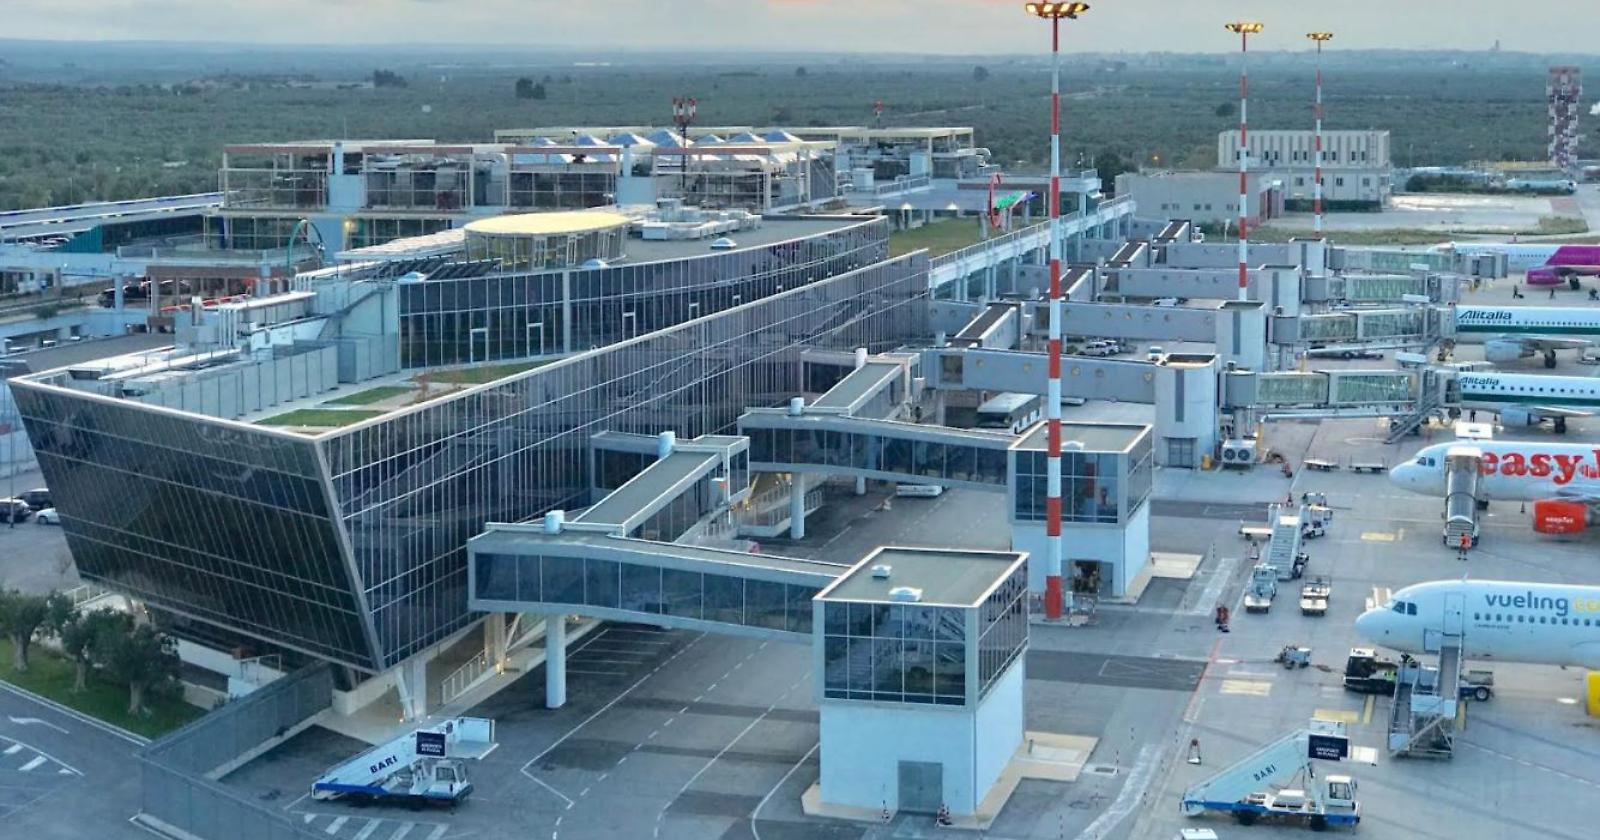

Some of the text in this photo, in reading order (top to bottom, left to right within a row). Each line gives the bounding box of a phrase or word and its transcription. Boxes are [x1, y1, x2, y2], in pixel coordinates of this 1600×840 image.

[1459, 310, 1512, 319] Alitalia
[1458, 376, 1499, 386] Alitalia
[1485, 590, 1569, 617] vueling
[369, 754, 398, 774] BARI
[1253, 764, 1276, 781] BARI
